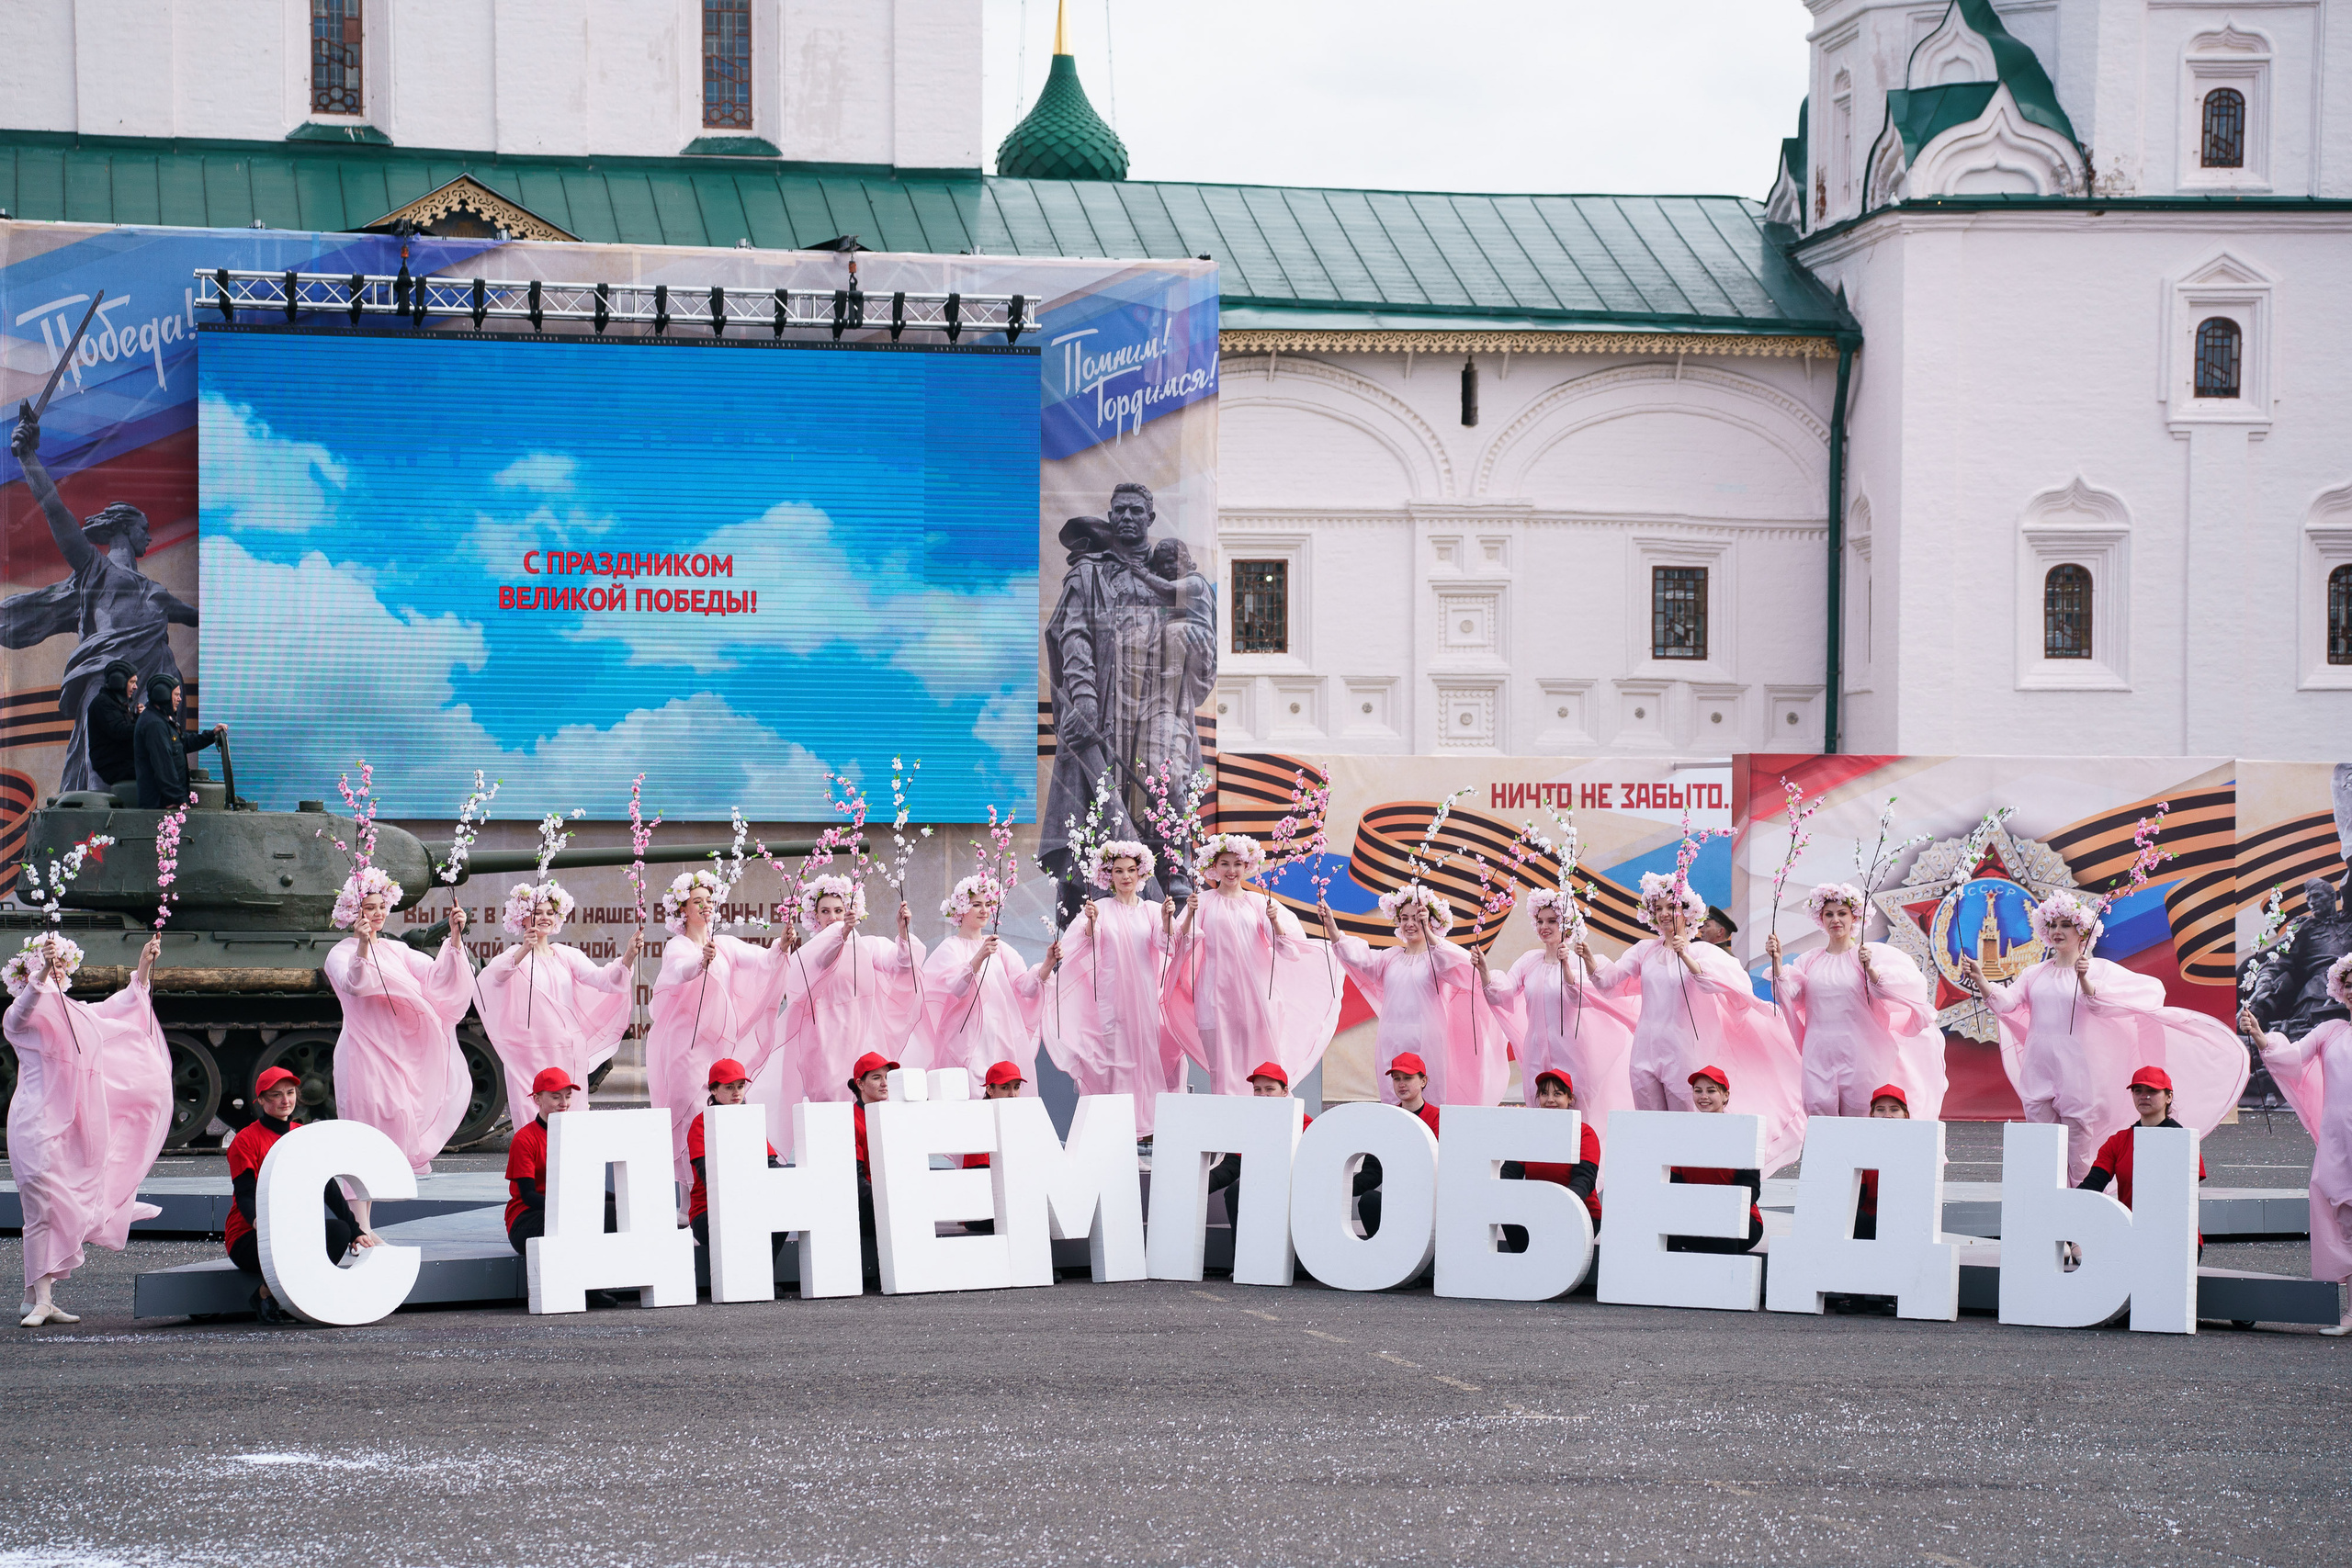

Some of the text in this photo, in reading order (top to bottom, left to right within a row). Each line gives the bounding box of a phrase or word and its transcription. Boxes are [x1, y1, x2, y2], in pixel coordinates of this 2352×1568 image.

[17, 288, 196, 393] Победа!
[1051, 318, 1171, 397] Помним!
[1082, 351, 1218, 447] Гордимся!
[524, 550, 733, 579] С ПРАЗДНИКОМ
[499, 583, 757, 616] ВЕЛИКОЙ ПОБЕДЫ!
[1491, 784, 1572, 808] НИЧТО
[1581, 784, 1612, 808] НЕ
[1968, 885, 2016, 897] СССР
[256, 1067, 2200, 1335] С ДНЁМ ПОБЕДЫ
